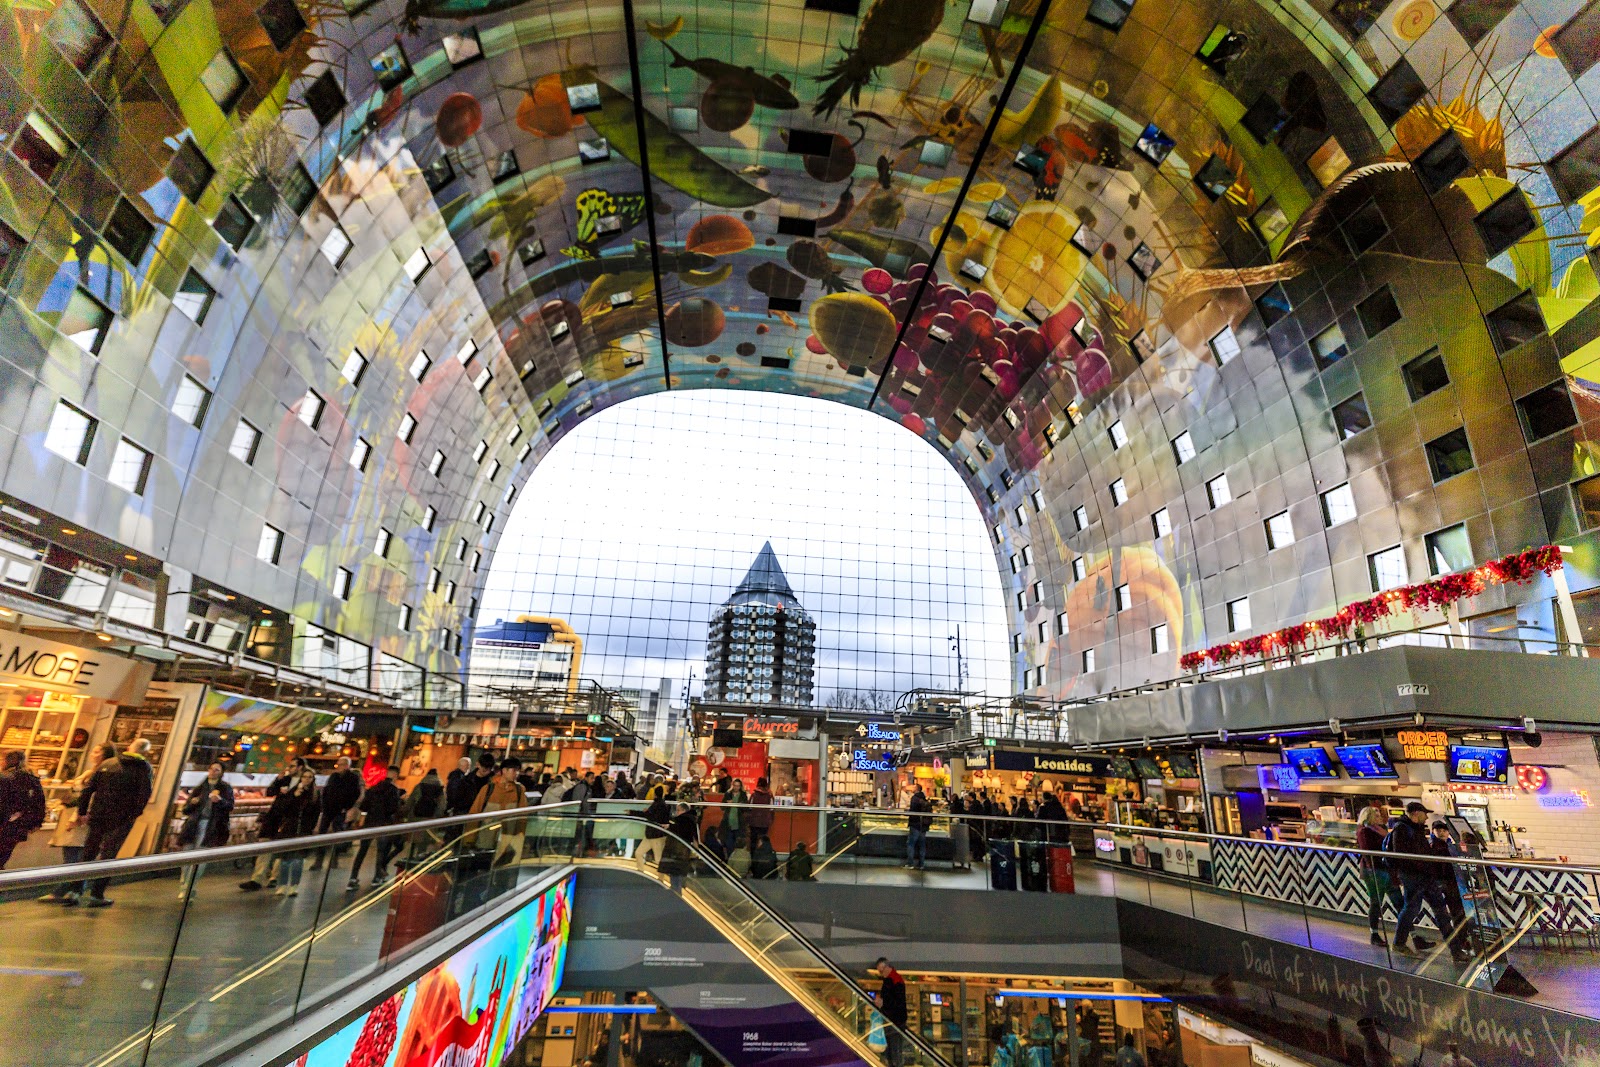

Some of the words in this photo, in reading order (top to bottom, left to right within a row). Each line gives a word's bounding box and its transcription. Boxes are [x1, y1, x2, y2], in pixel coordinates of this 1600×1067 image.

[3, 646, 99, 686] MORE
[743, 719, 798, 733] Churros
[1397, 731, 1449, 746] ORDER
[854, 750, 867, 759] DE
[1404, 745, 1447, 760] HERE
[966, 756, 987, 767] Leonidas
[1033, 757, 1093, 773] Leonidas
[1072, 784, 1096, 792] Leonidas
[644, 948, 662, 956] 2000
[1241, 940, 1278, 980] Daal
[1283, 954, 1304, 994] af
[1308, 956, 1329, 995] in
[1333, 964, 1369, 1008] het
[1377, 976, 1535, 1057] Rotterdams
[742, 1032, 759, 1041] 1968
